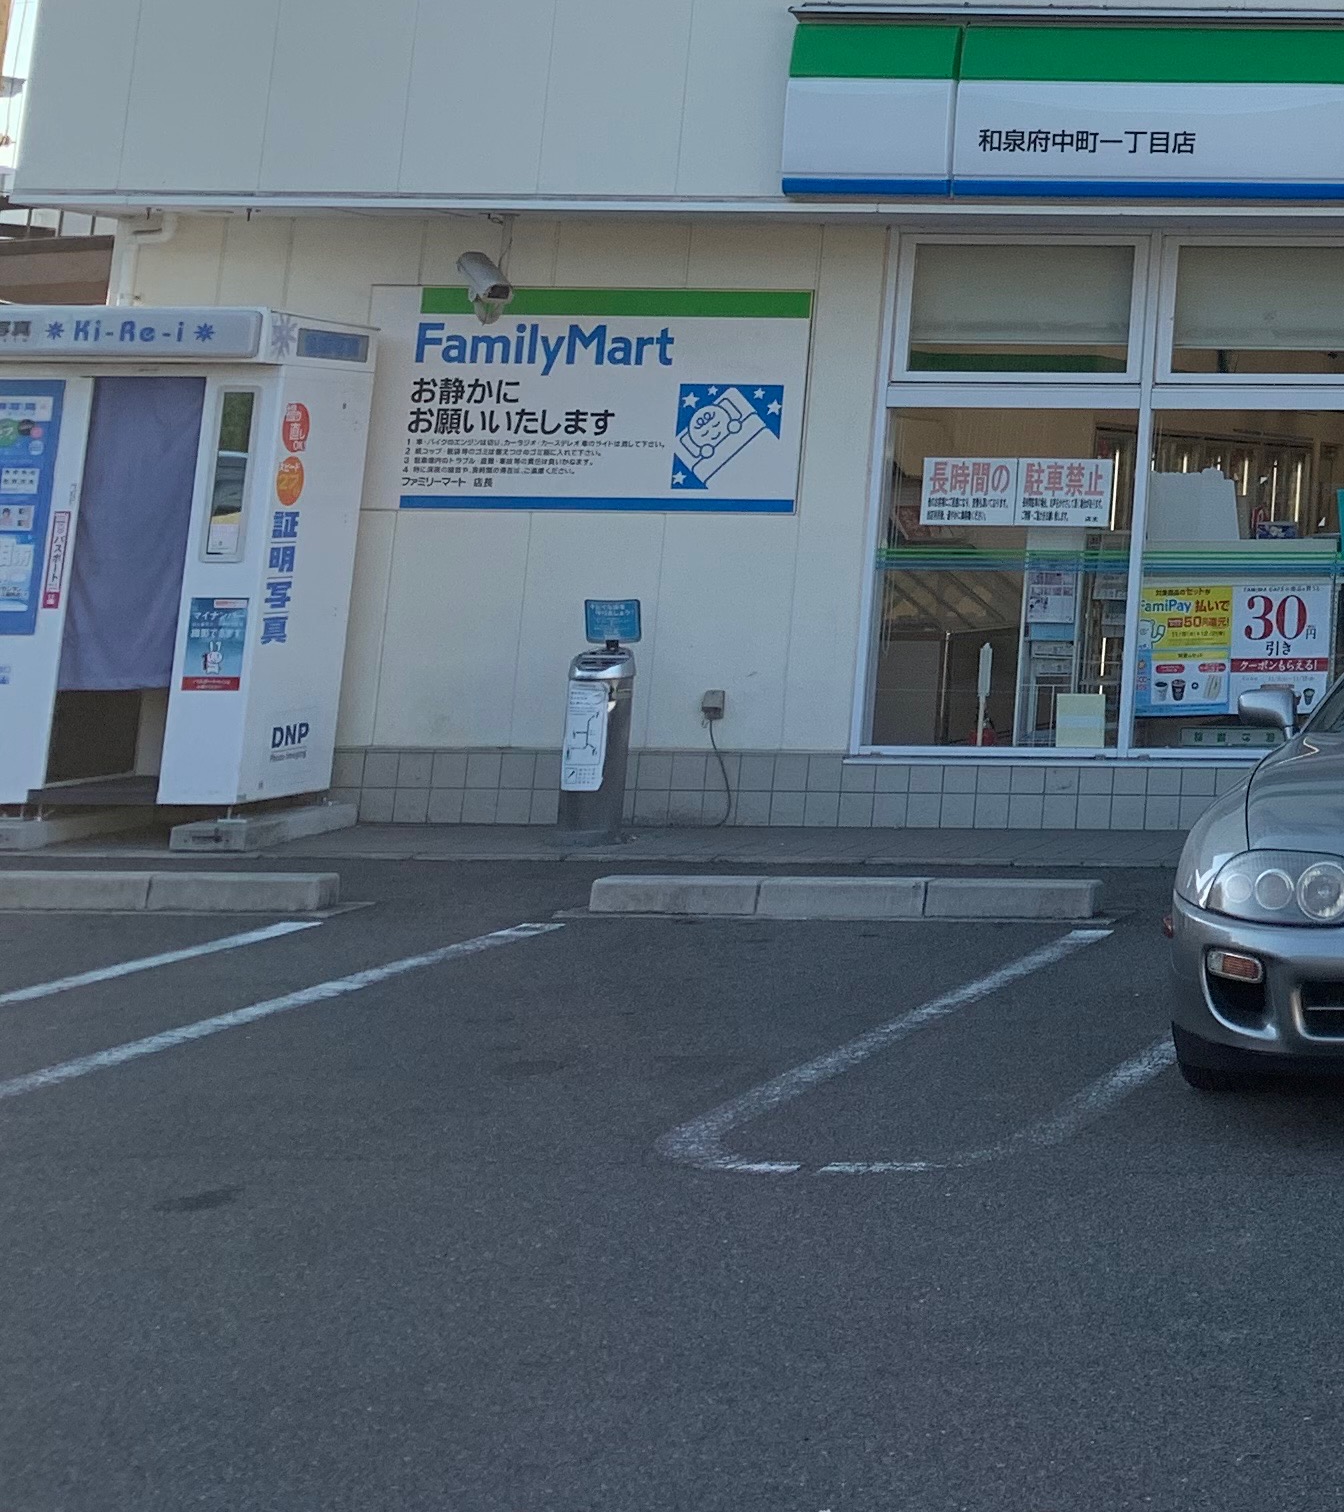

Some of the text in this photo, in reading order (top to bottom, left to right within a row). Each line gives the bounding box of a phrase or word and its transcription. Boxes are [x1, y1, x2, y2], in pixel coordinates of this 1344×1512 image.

[978, 128, 1197, 156] 和泉府中町一丁目店
[414, 322, 675, 376] FamilyMart
[410, 377, 521, 405] お静かに
[407, 408, 616, 437] お願いいたします
[401, 477, 494, 488] ファミリーマート 店長
[930, 459, 1011, 496] 長時間の
[1023, 461, 1105, 497] 駐車禁止
[260, 511, 300, 645] 証明写真
[1266, 640, 1292, 656] 引き
[1240, 659, 1318, 671] クーポンもらえる!
[270, 721, 310, 750] DNP
